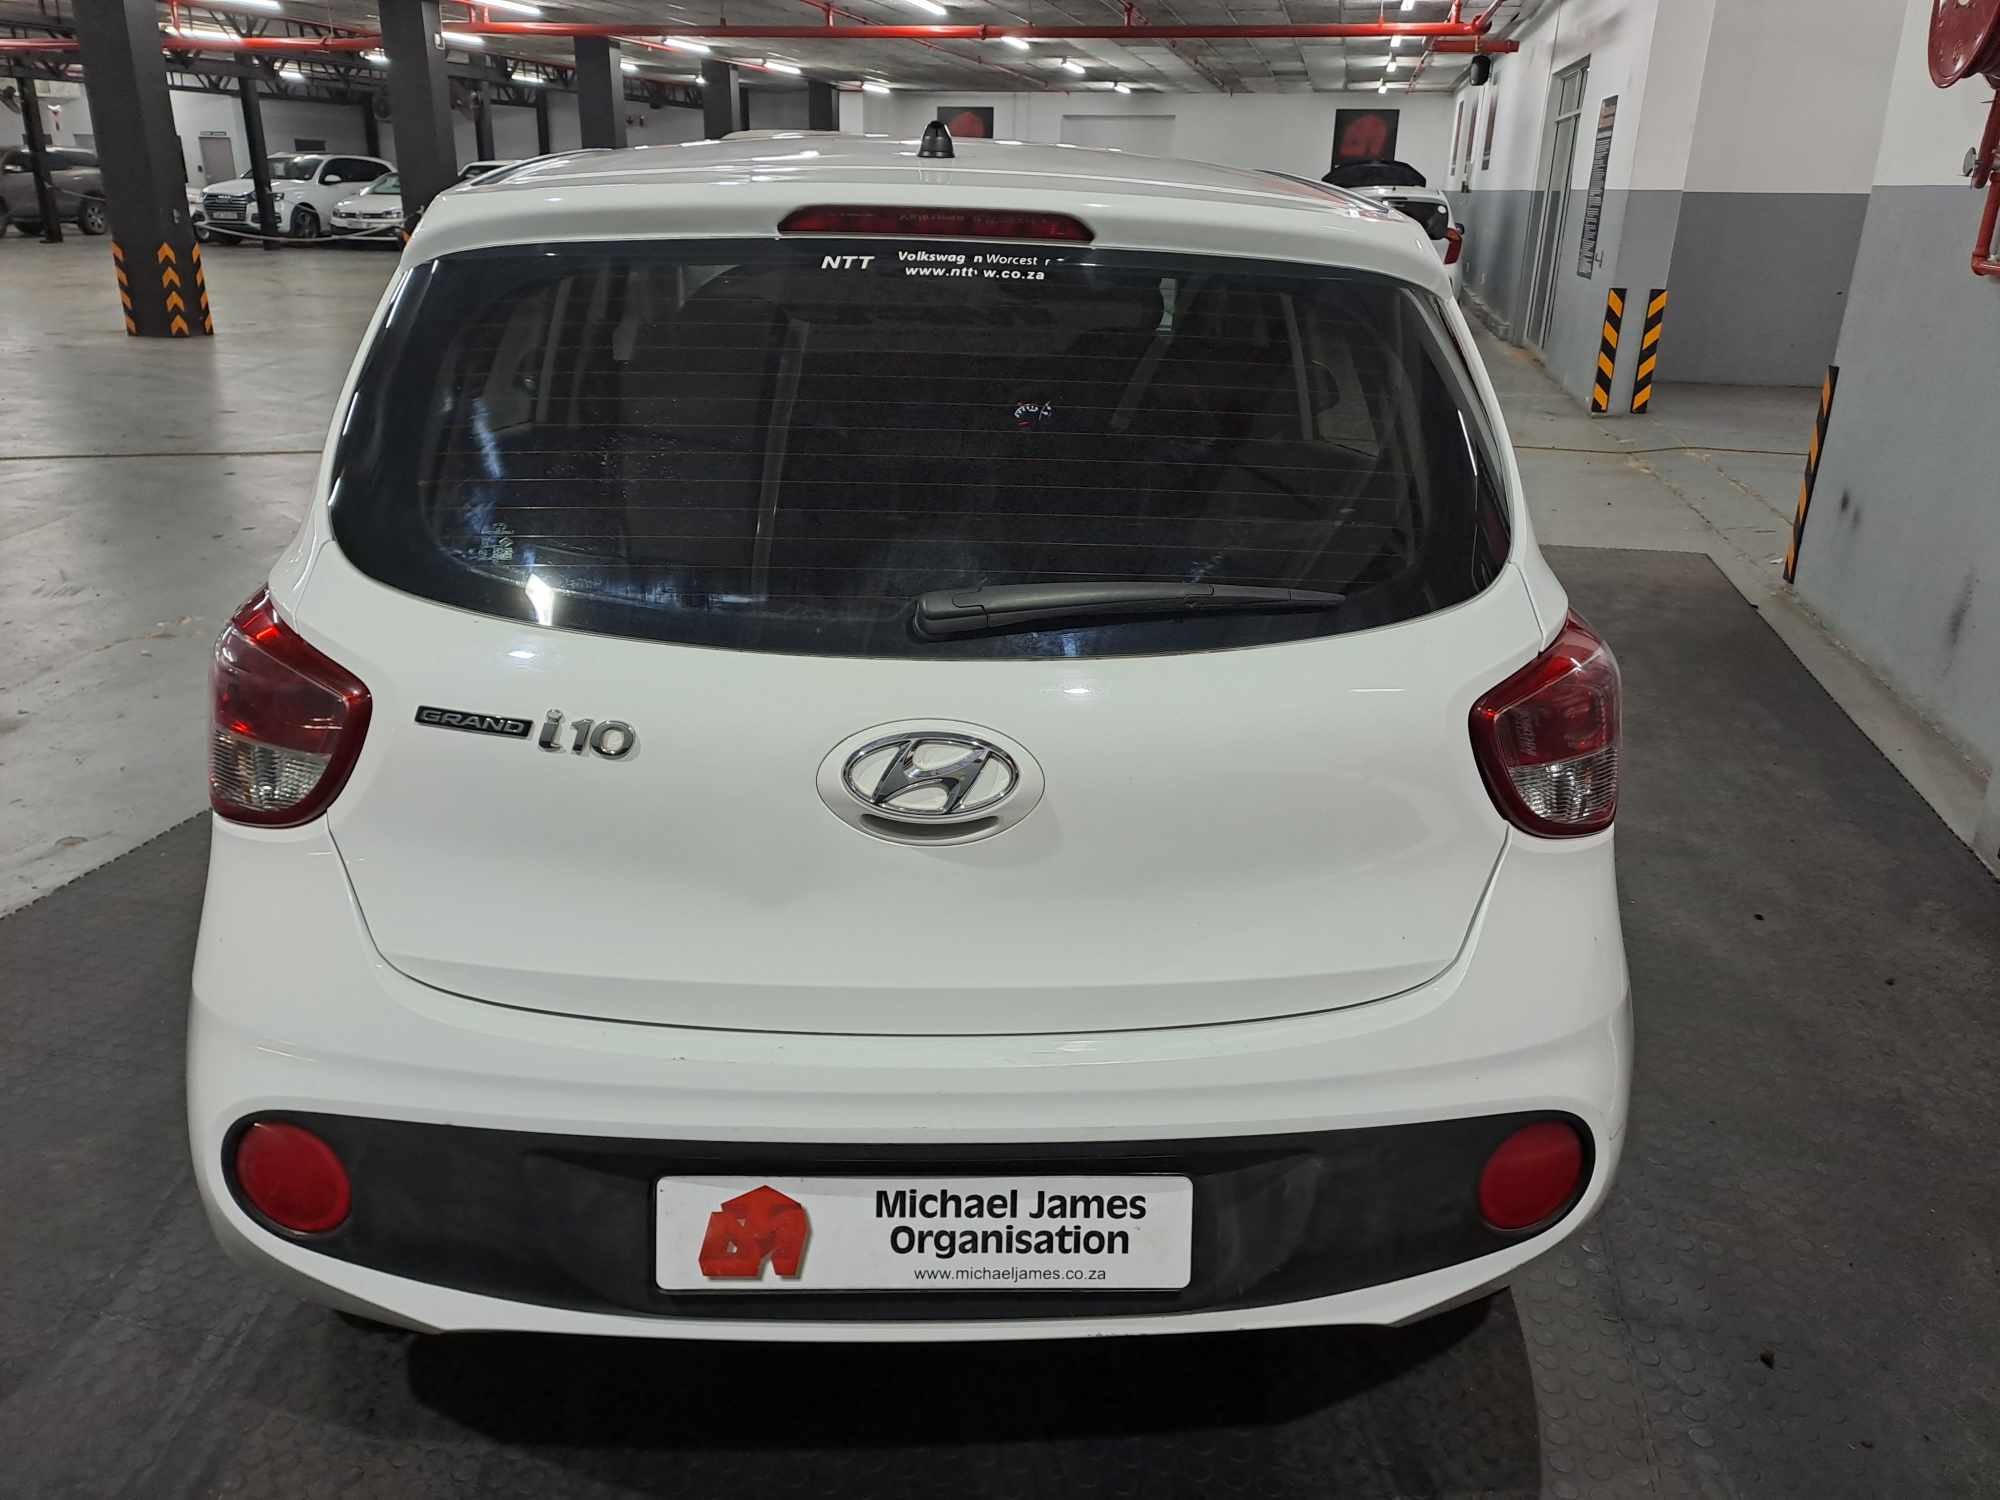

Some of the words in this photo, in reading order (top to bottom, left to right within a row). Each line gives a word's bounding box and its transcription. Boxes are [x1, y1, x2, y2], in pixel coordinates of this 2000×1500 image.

[821, 255, 875, 270] NTT
[897, 251, 983, 264] Volkswagn
[985, 254, 1051, 266] Worcestr
[905, 266, 1046, 280] www.nttw.co.za
[420, 709, 525, 734] GRAND
[538, 708, 637, 760] i10
[875, 1189, 1018, 1219] Michael
[1029, 1190, 1147, 1219] James
[889, 1224, 1130, 1259] Organisation
[913, 1267, 1107, 1282] www.michaeljames.co.za
